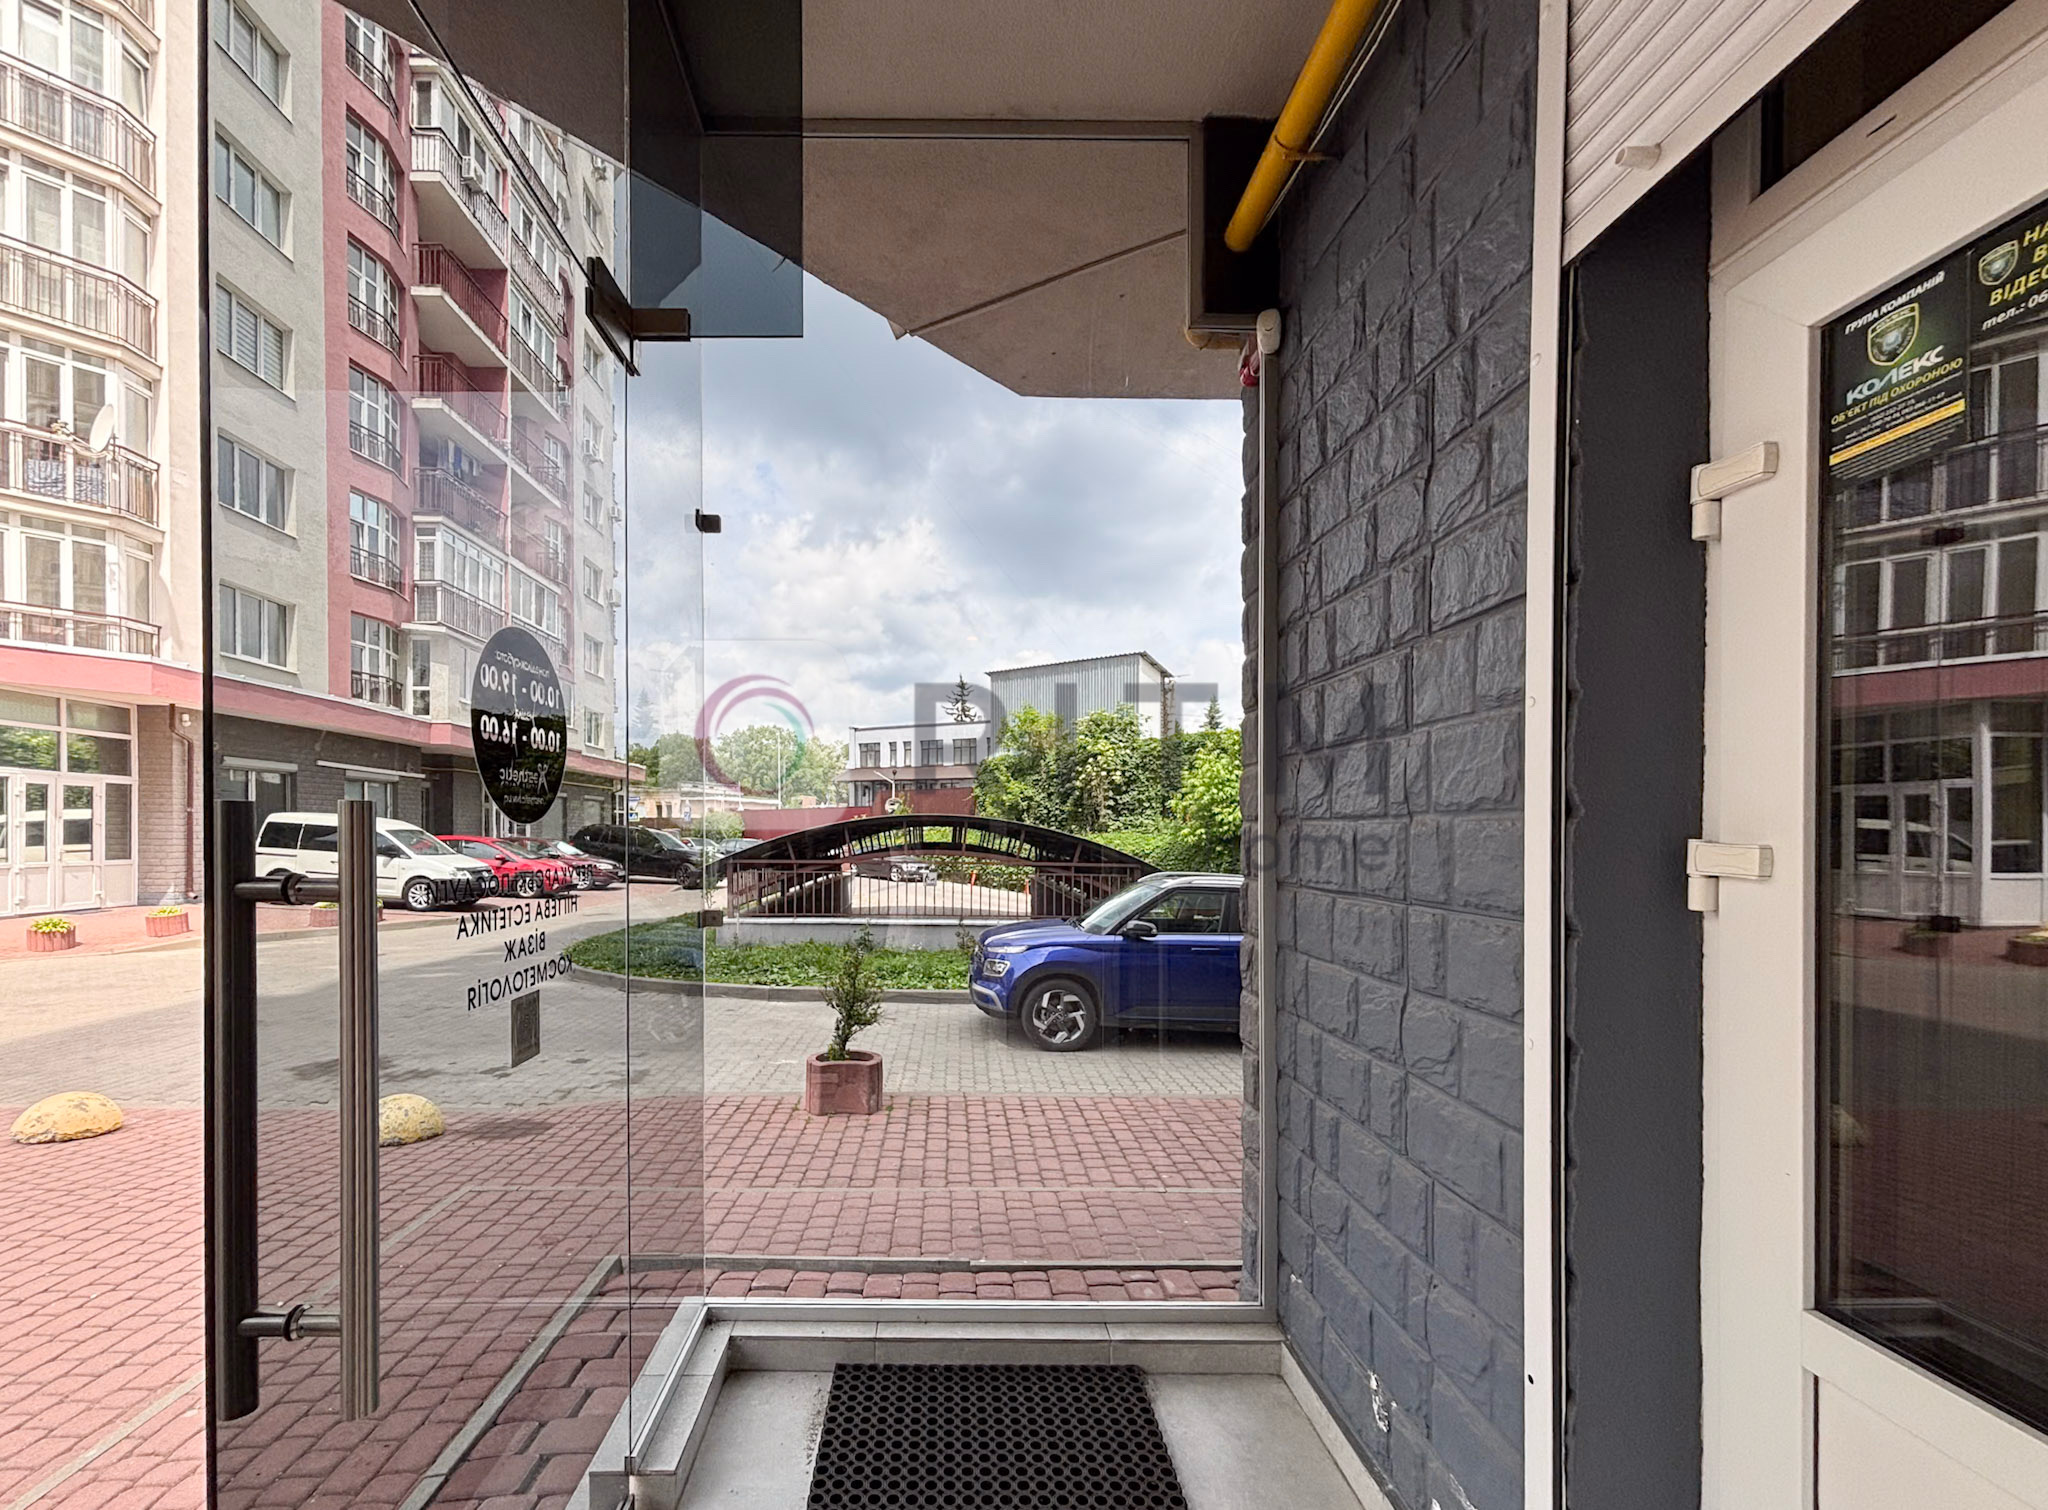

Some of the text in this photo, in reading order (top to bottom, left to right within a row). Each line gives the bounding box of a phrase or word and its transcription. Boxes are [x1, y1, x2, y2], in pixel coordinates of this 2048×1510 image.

[1845, 308, 1879, 335] ГРУПА
[1880, 270, 1946, 315] КОМПАНІЙ
[1846, 345, 1944, 406] КОЛЕКС
[1869, 392, 1889, 409] ПІД
[1890, 357, 1963, 397] ОХОРОНОЮ
